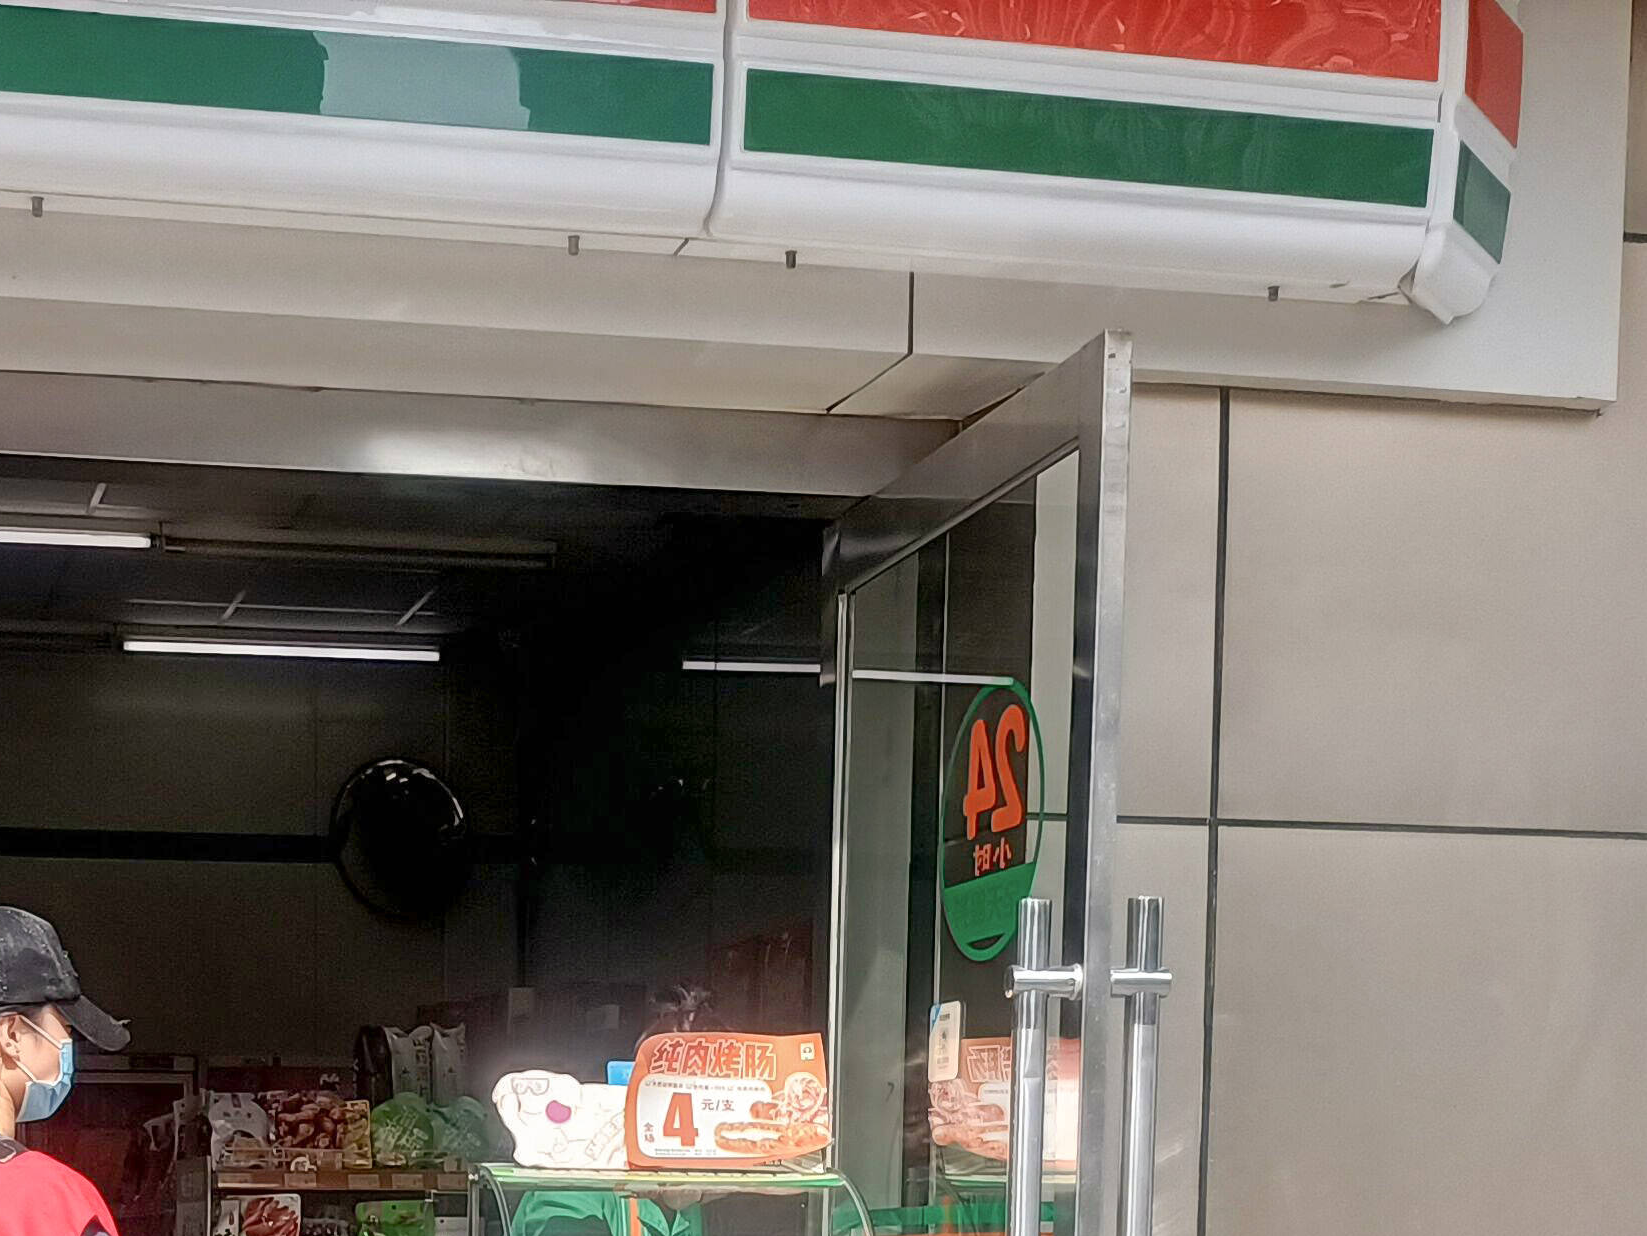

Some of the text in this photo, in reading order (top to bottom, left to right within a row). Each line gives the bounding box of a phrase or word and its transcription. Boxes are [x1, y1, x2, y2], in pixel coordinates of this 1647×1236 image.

[649, 1036, 778, 1081] 纯肉烤肠
[663, 1092, 699, 1147] 4
[701, 1098, 736, 1112] 元/支
